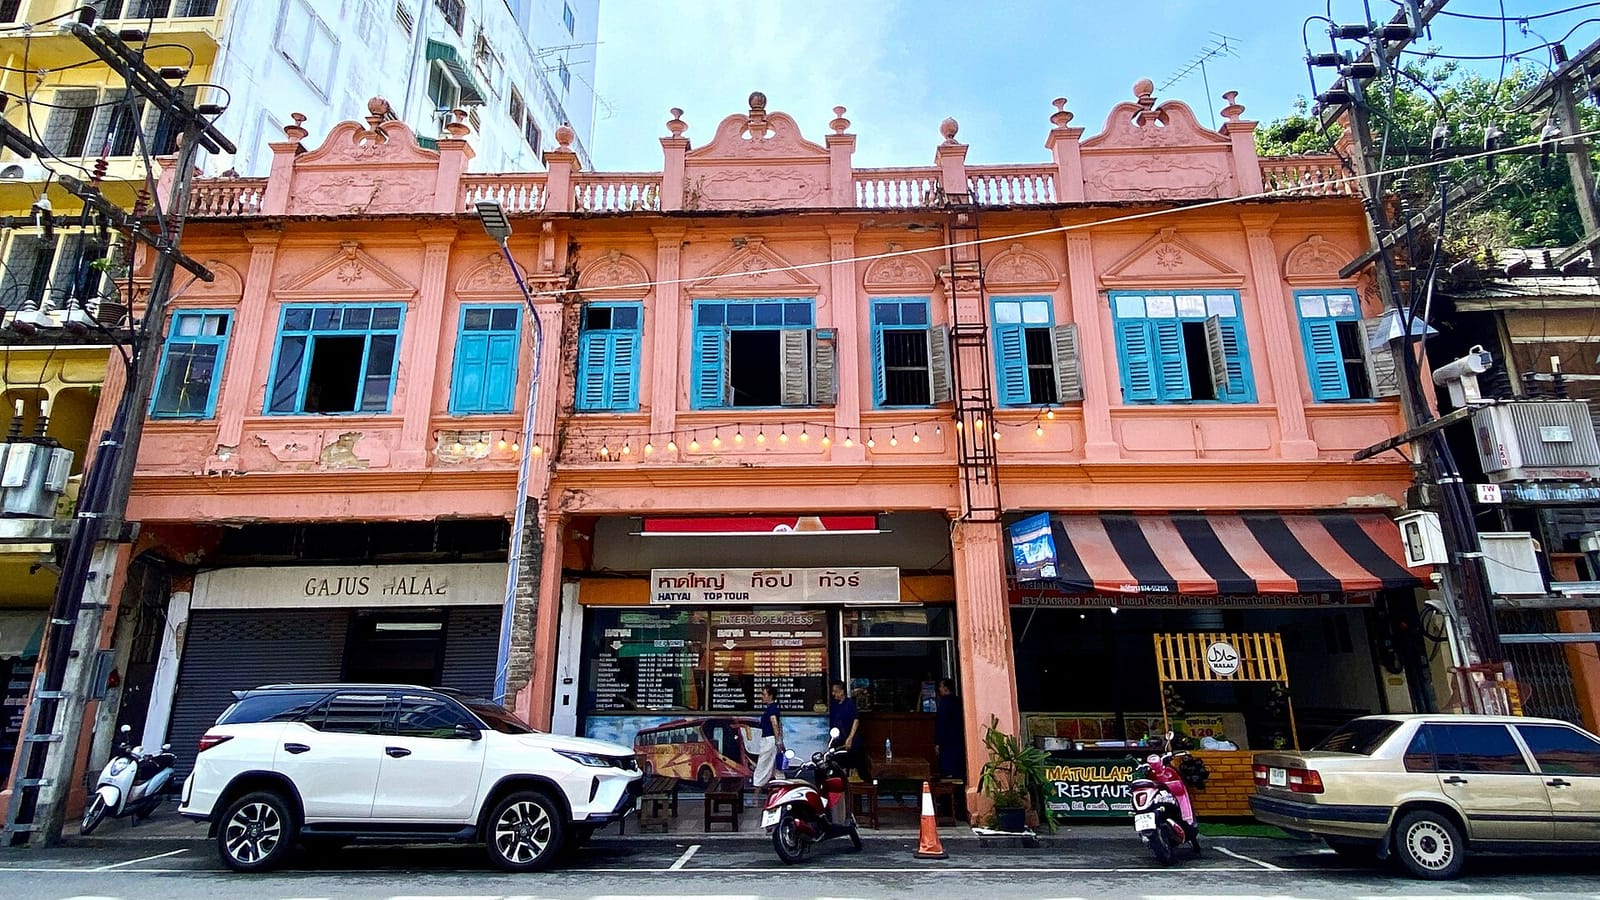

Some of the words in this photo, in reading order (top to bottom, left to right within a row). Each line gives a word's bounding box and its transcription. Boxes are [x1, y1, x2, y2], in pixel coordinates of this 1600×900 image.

[304, 576, 370, 596] GAJUS
[658, 572, 725, 590] หาดใหญ่
[752, 572, 792, 588] ท็อป
[818, 571, 860, 588] ทัวร์
[658, 592, 690, 600] HATYAI
[703, 592, 722, 600] TOP
[724, 592, 749, 600] TOUR
[1146, 594, 1177, 606] Kedai
[1179, 594, 1215, 606] Makan
[720, 615, 749, 625] INTER
[750, 615, 769, 625] TOP
[770, 615, 814, 625] EXPRESS
[1208, 647, 1237, 663] حلال
